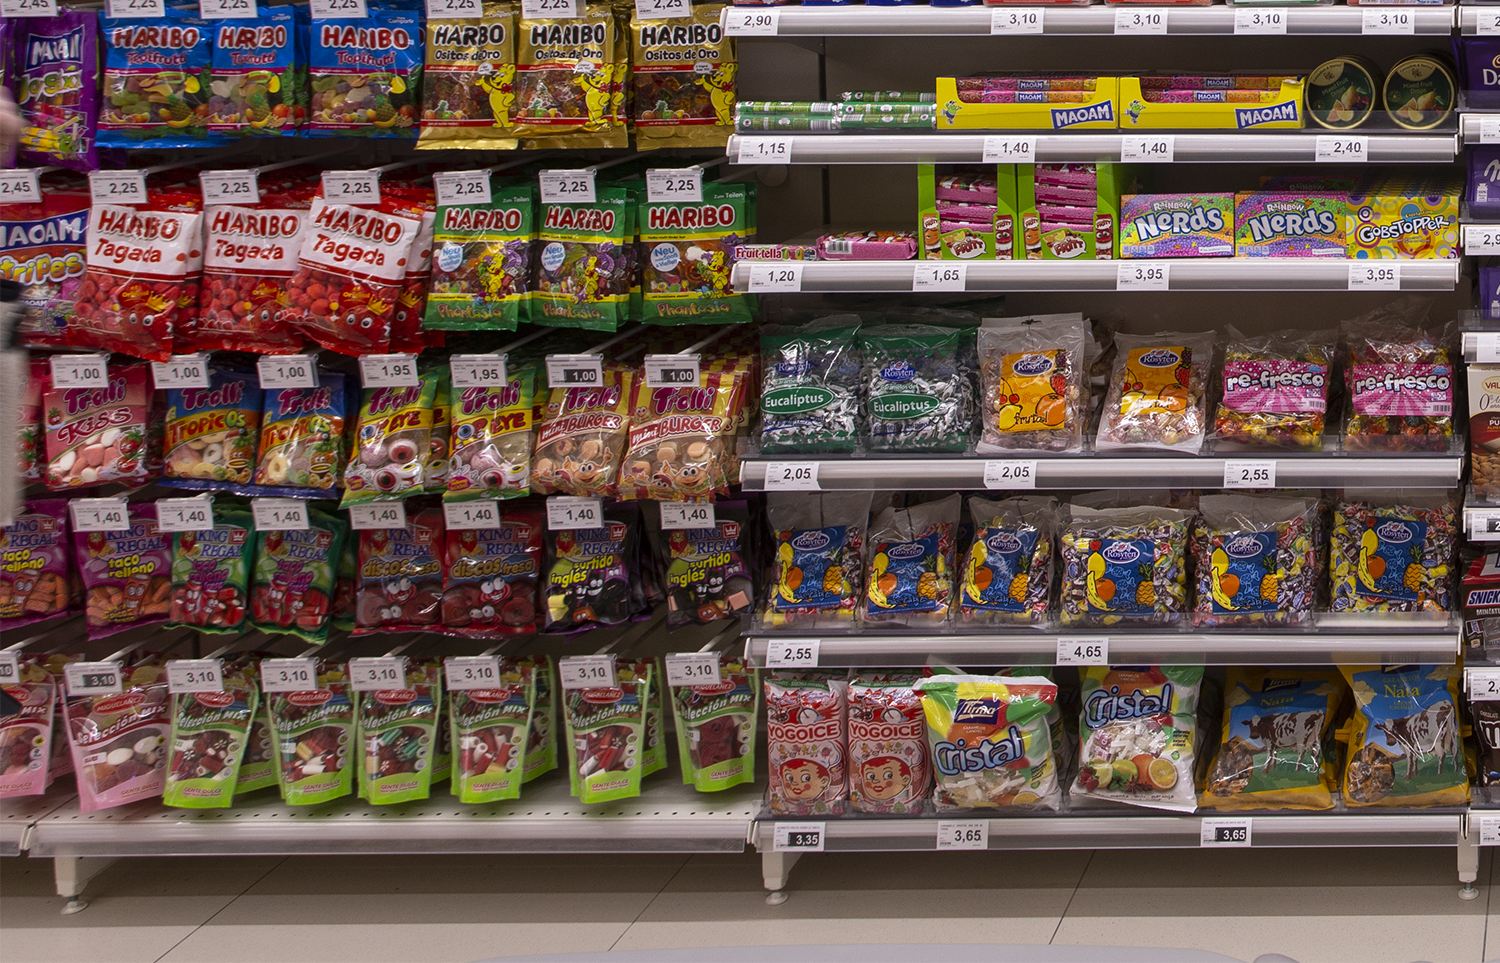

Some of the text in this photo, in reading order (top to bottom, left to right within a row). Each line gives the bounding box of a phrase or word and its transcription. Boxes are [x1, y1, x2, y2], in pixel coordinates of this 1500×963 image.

[641, 24, 722, 47] HARIBO
[645, 49, 718, 60] Ositos de Oro
[1239, 104, 1296, 126] MAOAM
[212, 212, 298, 238] HARIBO
[315, 205, 402, 245] HARIBO
[649, 205, 735, 228] HARIBO
[216, 239, 284, 263] Tagada
[654, 248, 676, 257] Neu
[1227, 372, 1325, 392] re-fresco
[653, 387, 713, 415] Trolli
[765, 391, 824, 409] Eucaliptus
[659, 417, 721, 436] BURGER
[689, 553, 731, 568] surtido
[670, 566, 705, 586] inglés
[1384, 684, 1420, 699] Nata
[769, 724, 838, 740] YOGOICE
[934, 726, 1023, 776] Cristal
